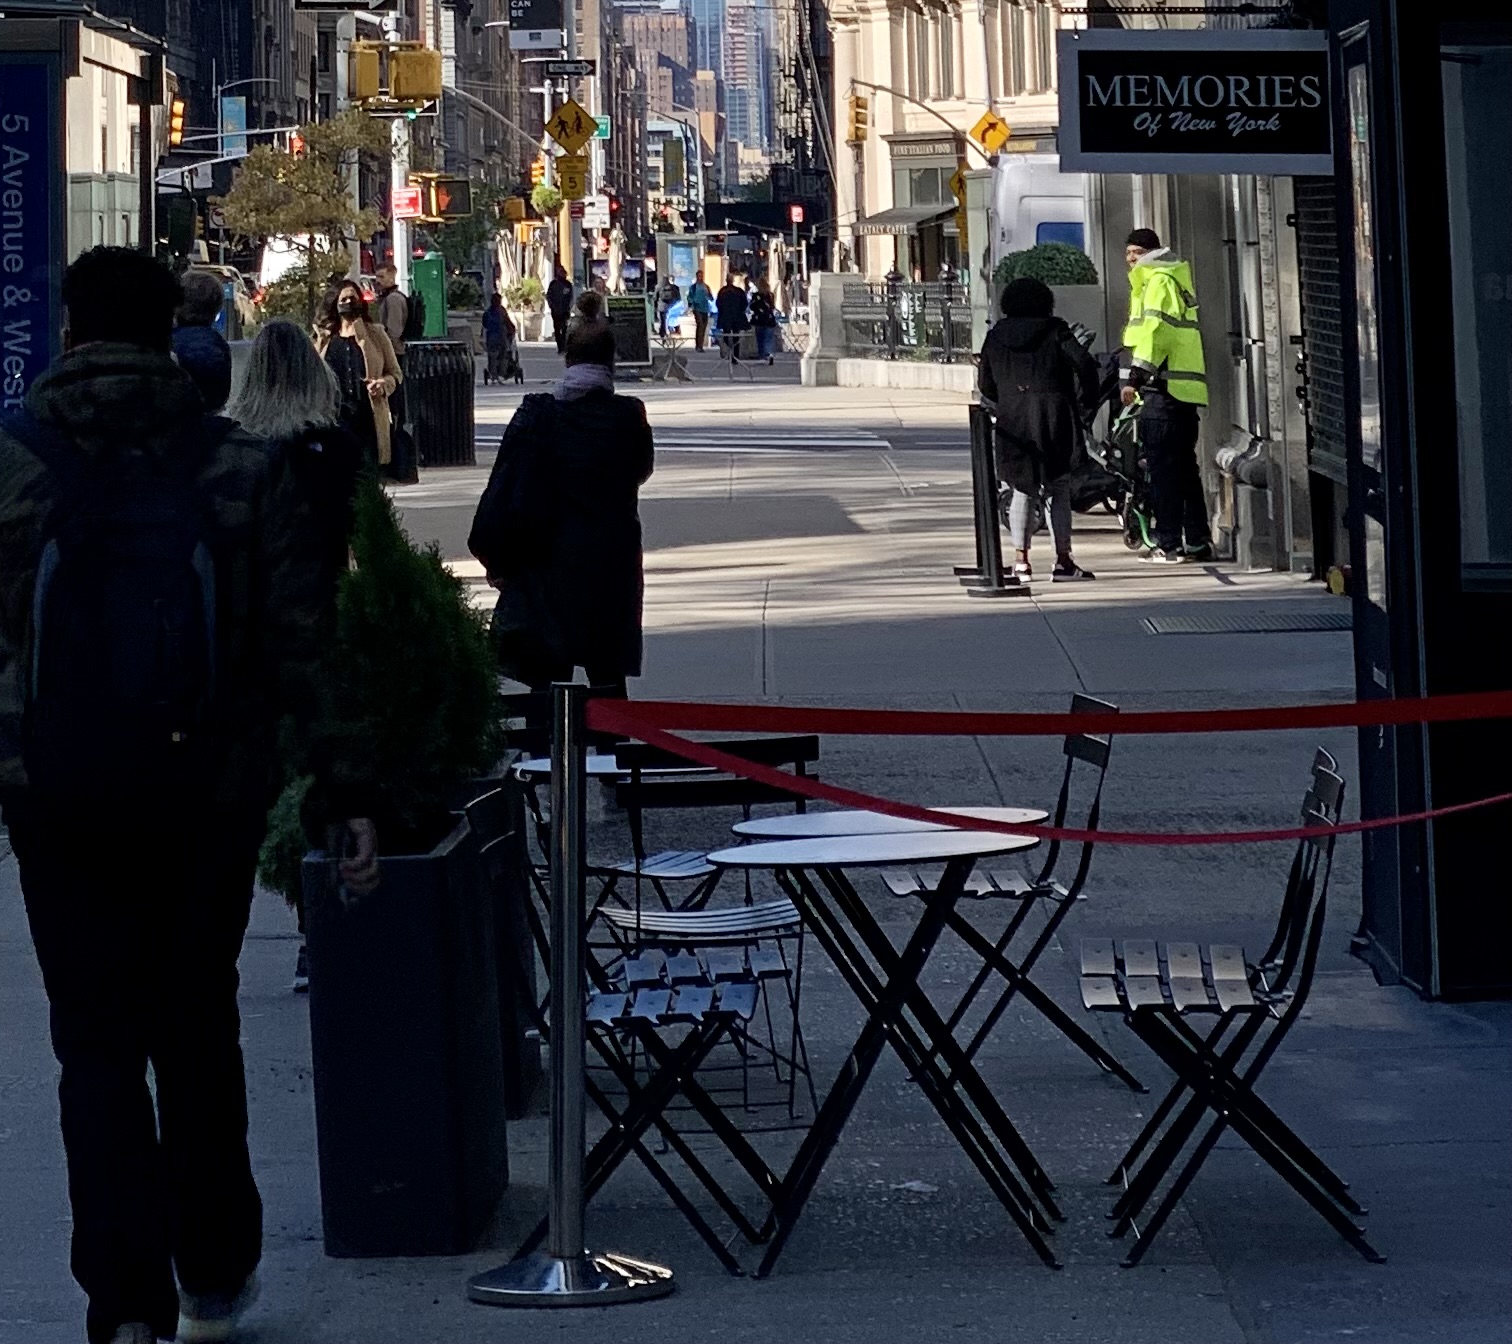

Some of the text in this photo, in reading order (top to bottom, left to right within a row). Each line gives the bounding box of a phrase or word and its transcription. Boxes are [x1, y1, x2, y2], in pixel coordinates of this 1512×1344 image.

[510, 0, 531, 8] CAN
[1084, 74, 1322, 108] MEMORIES
[1133, 111, 1282, 137] Of New York
[568, 176, 577, 189] 5
[859, 225, 885, 235] EATALY
[1, 114, 32, 412] 5 Avenue & West
